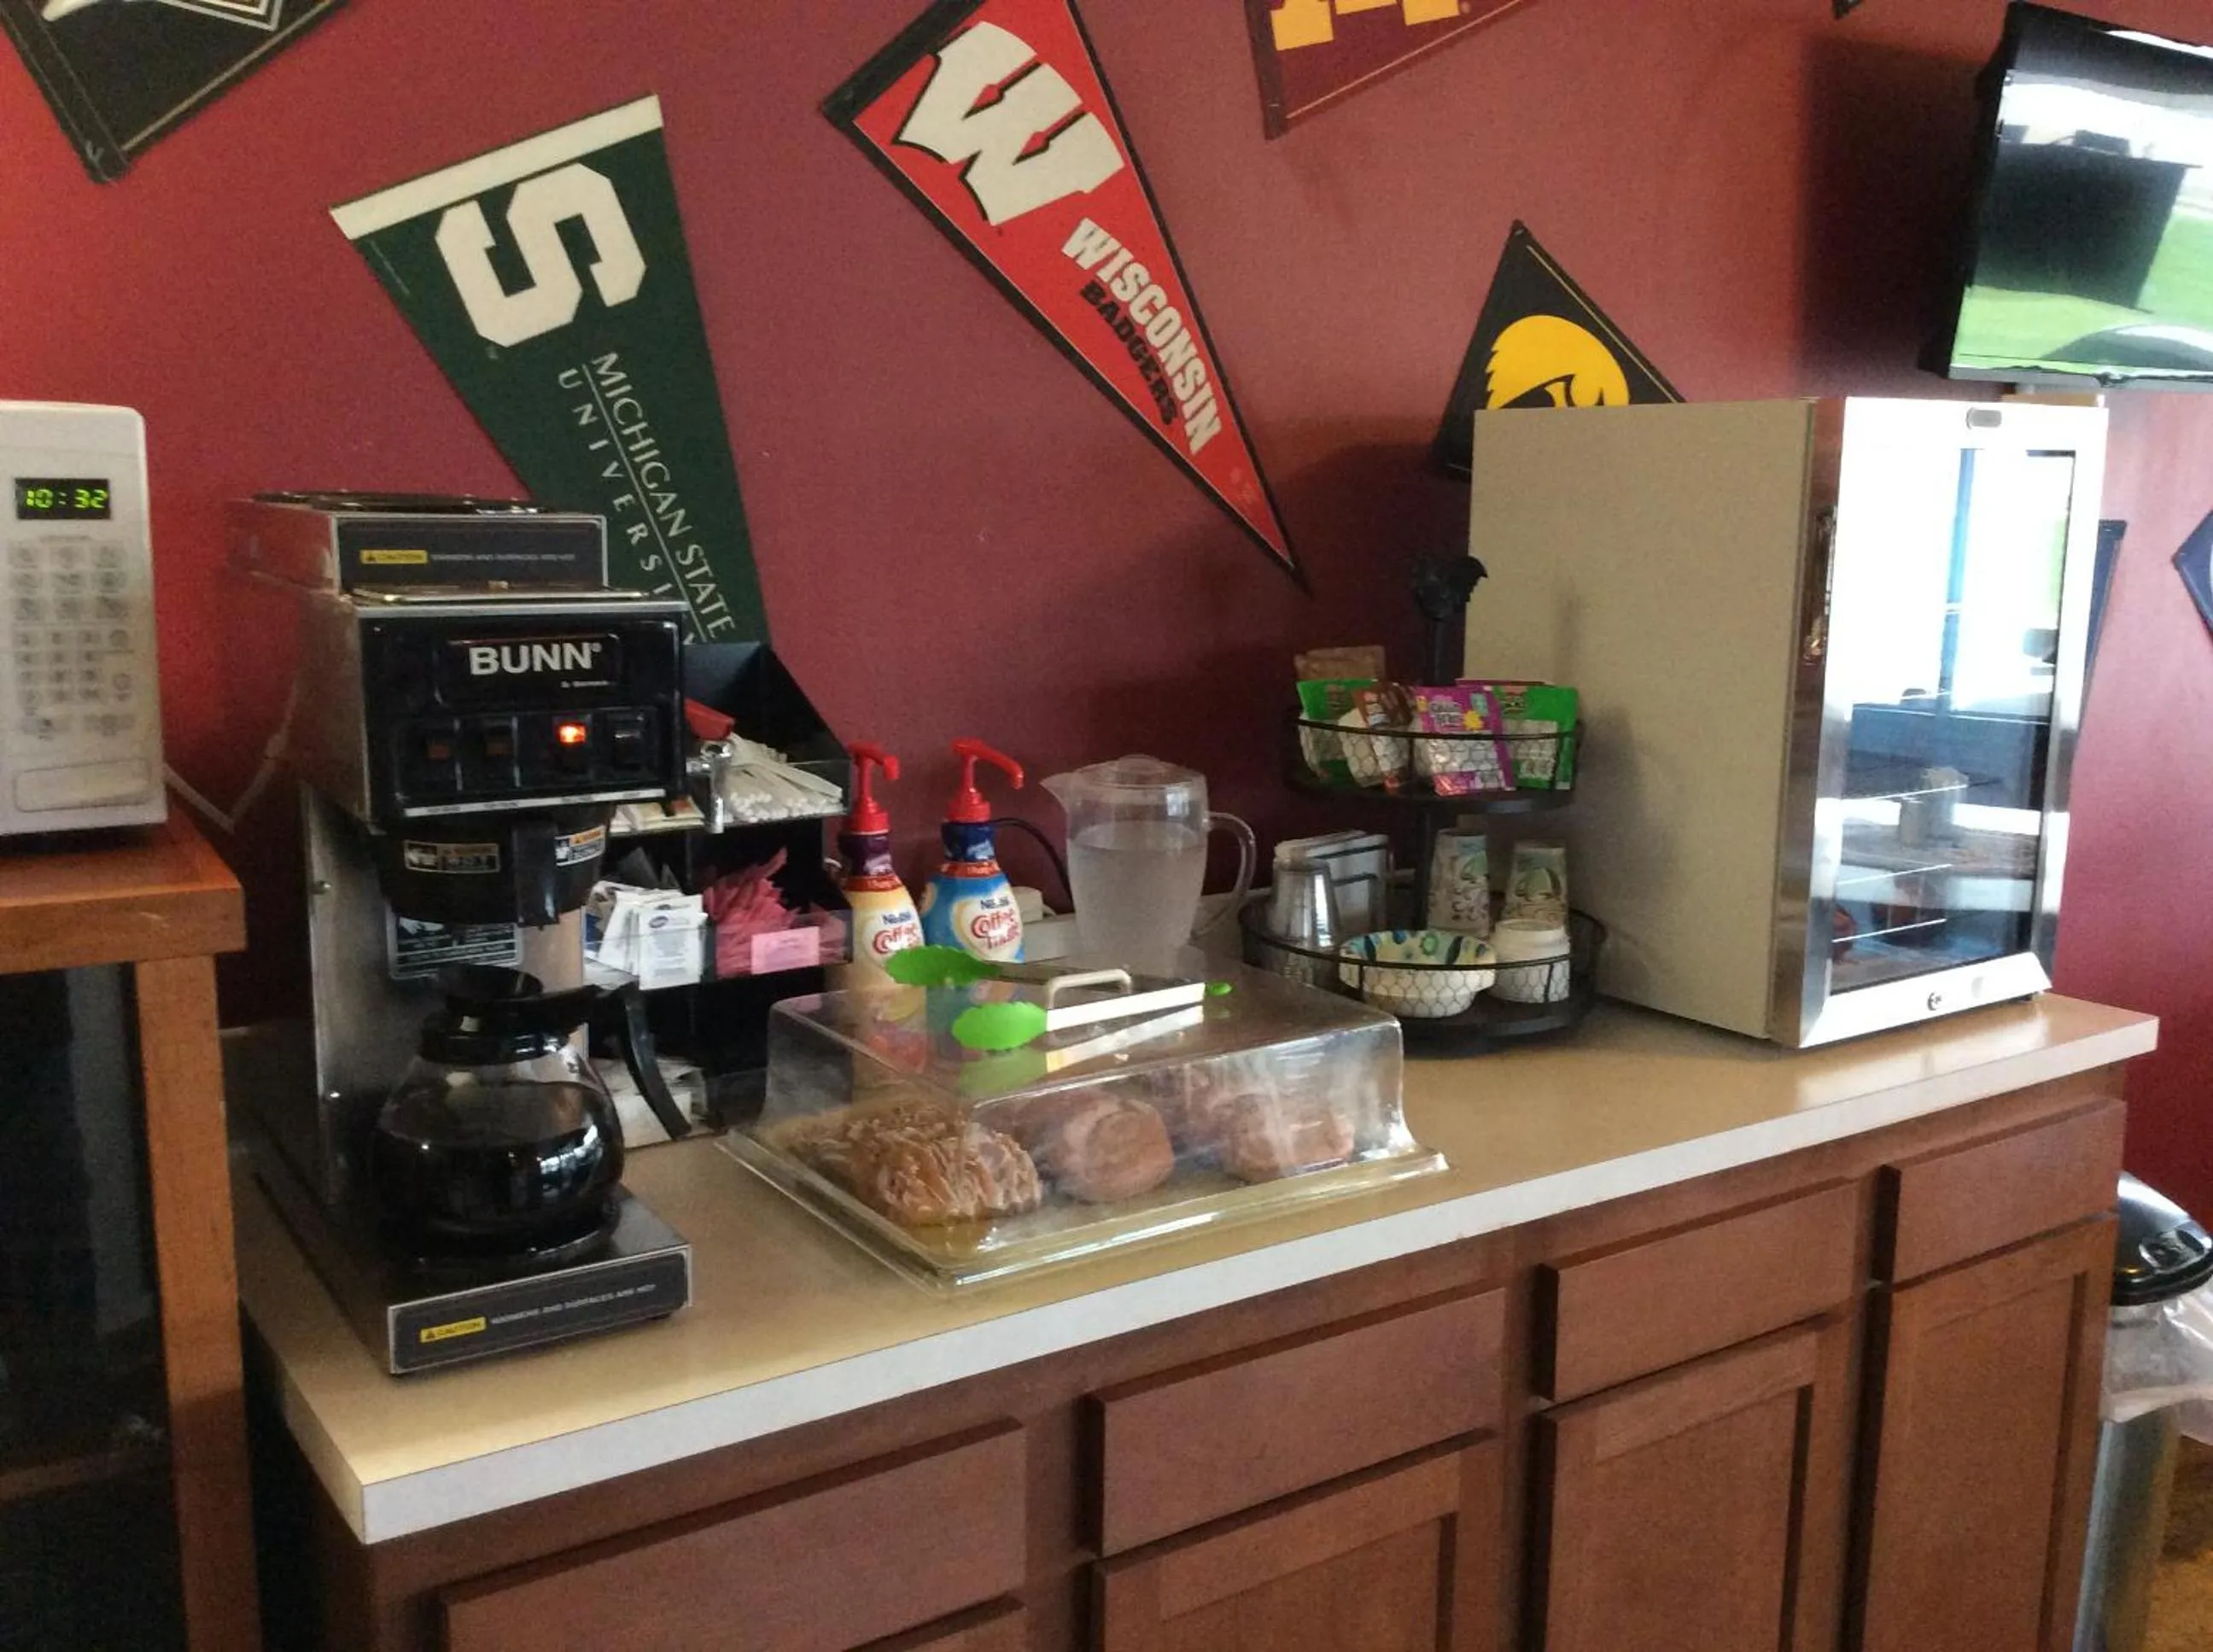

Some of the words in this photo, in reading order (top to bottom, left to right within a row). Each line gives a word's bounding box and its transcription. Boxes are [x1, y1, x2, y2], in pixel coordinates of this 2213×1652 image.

[890, 20, 1125, 226] W
[435, 162, 647, 348] S
[1060, 217, 1223, 455] WISCONSIN
[1078, 279, 1177, 426] BADGERS
[26, 487, 109, 509] 10:32
[558, 367, 697, 645] UNIVERSI
[591, 351, 693, 539] MICHIGAN
[674, 543, 736, 639] STATE
[469, 641, 594, 676] BUNN
